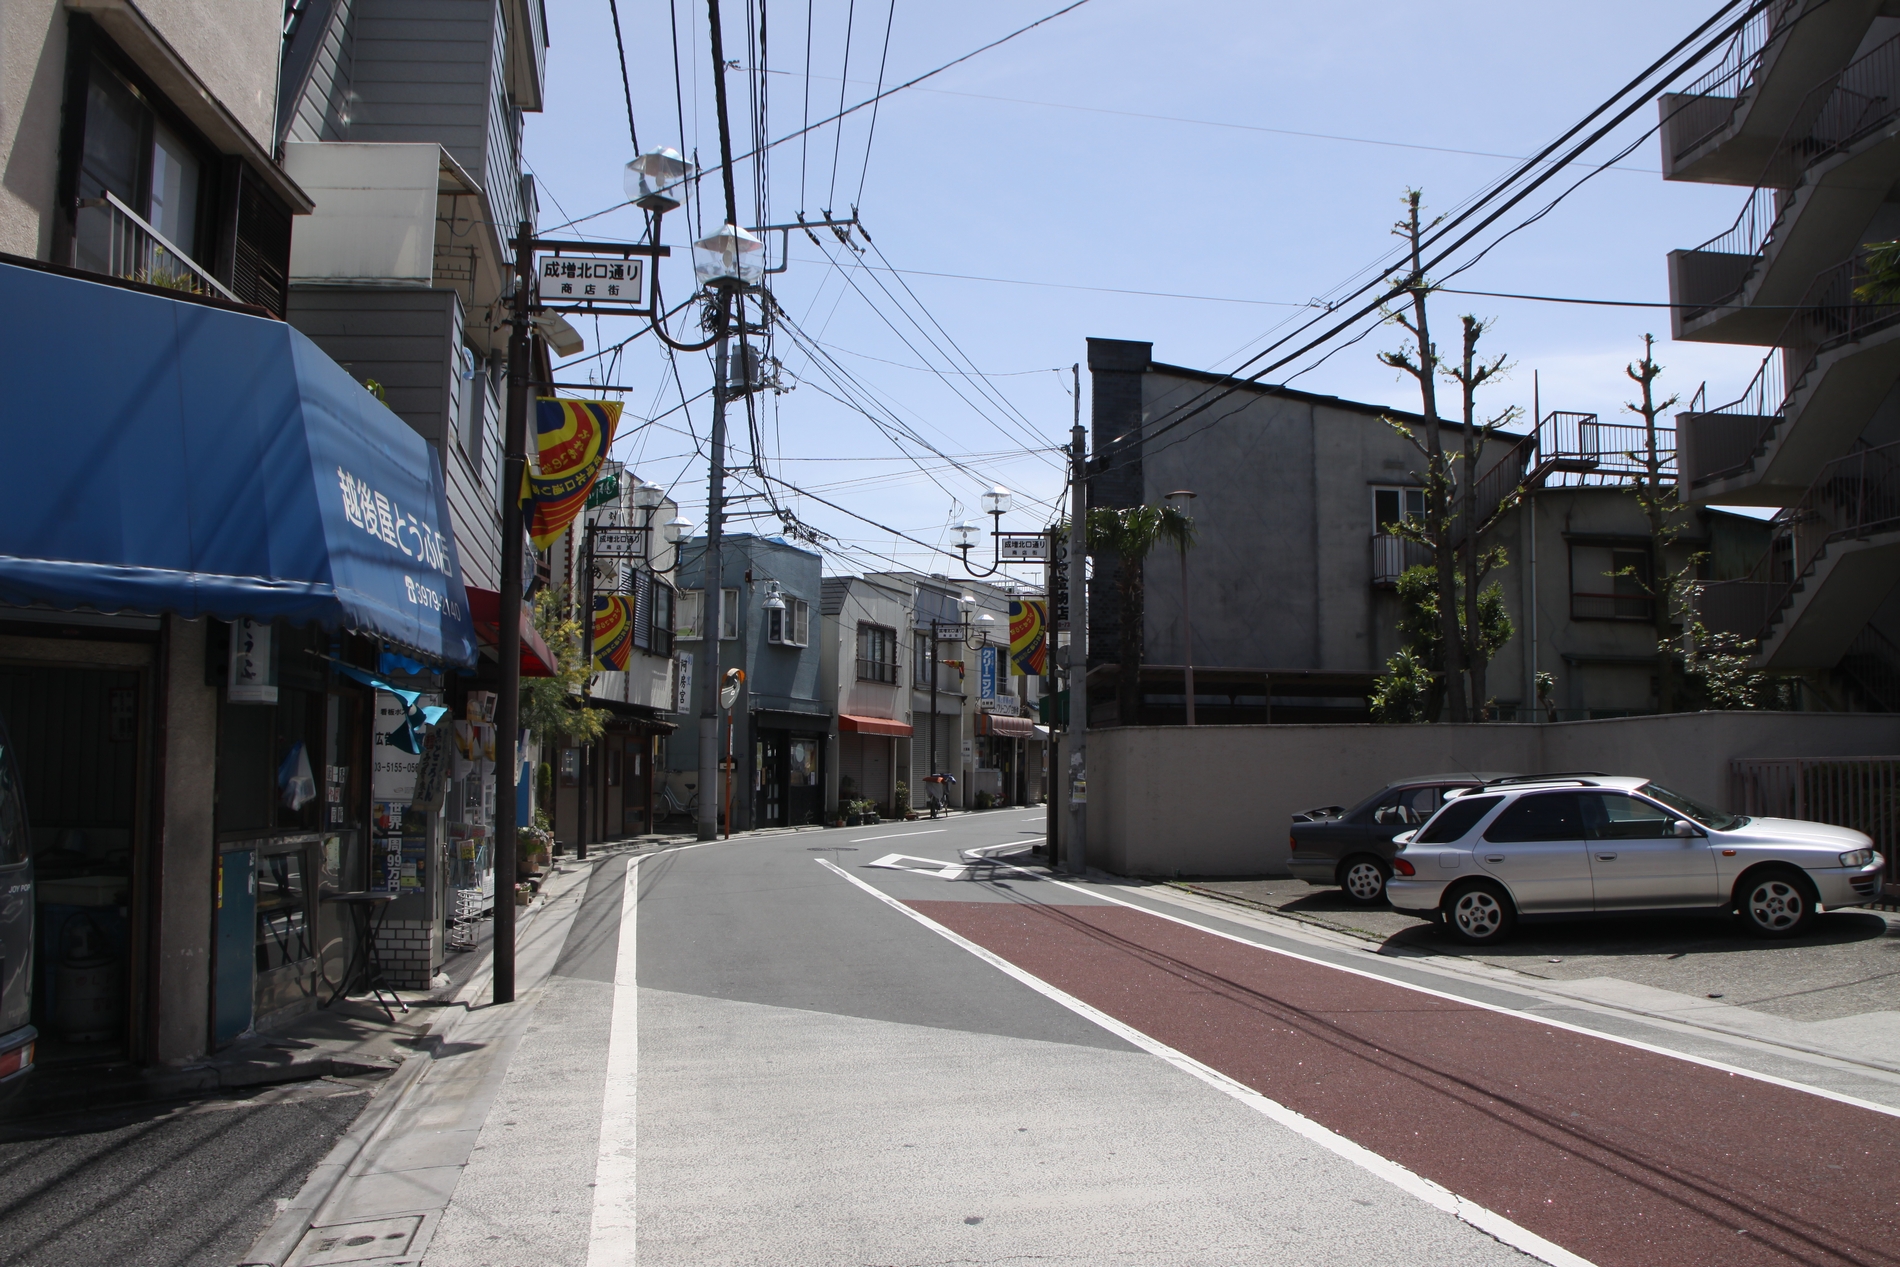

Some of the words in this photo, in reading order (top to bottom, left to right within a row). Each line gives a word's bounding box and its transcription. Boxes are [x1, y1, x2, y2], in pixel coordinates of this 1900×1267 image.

[544, 261, 638, 281] 成増北口通り
[561, 283, 620, 296] 商店街
[337, 466, 453, 578] 越後屋とうふ店
[599, 534, 640, 544] 成増北口通り
[1004, 541, 1045, 549] 成増北口通り
[415, 582, 461, 622] 3979-2140
[982, 649, 992, 698] クリーニング
[387, 802, 403, 891] 世界一周99万円
[8, 885, 20, 893] JOY
[20, 883, 31, 892] POP
